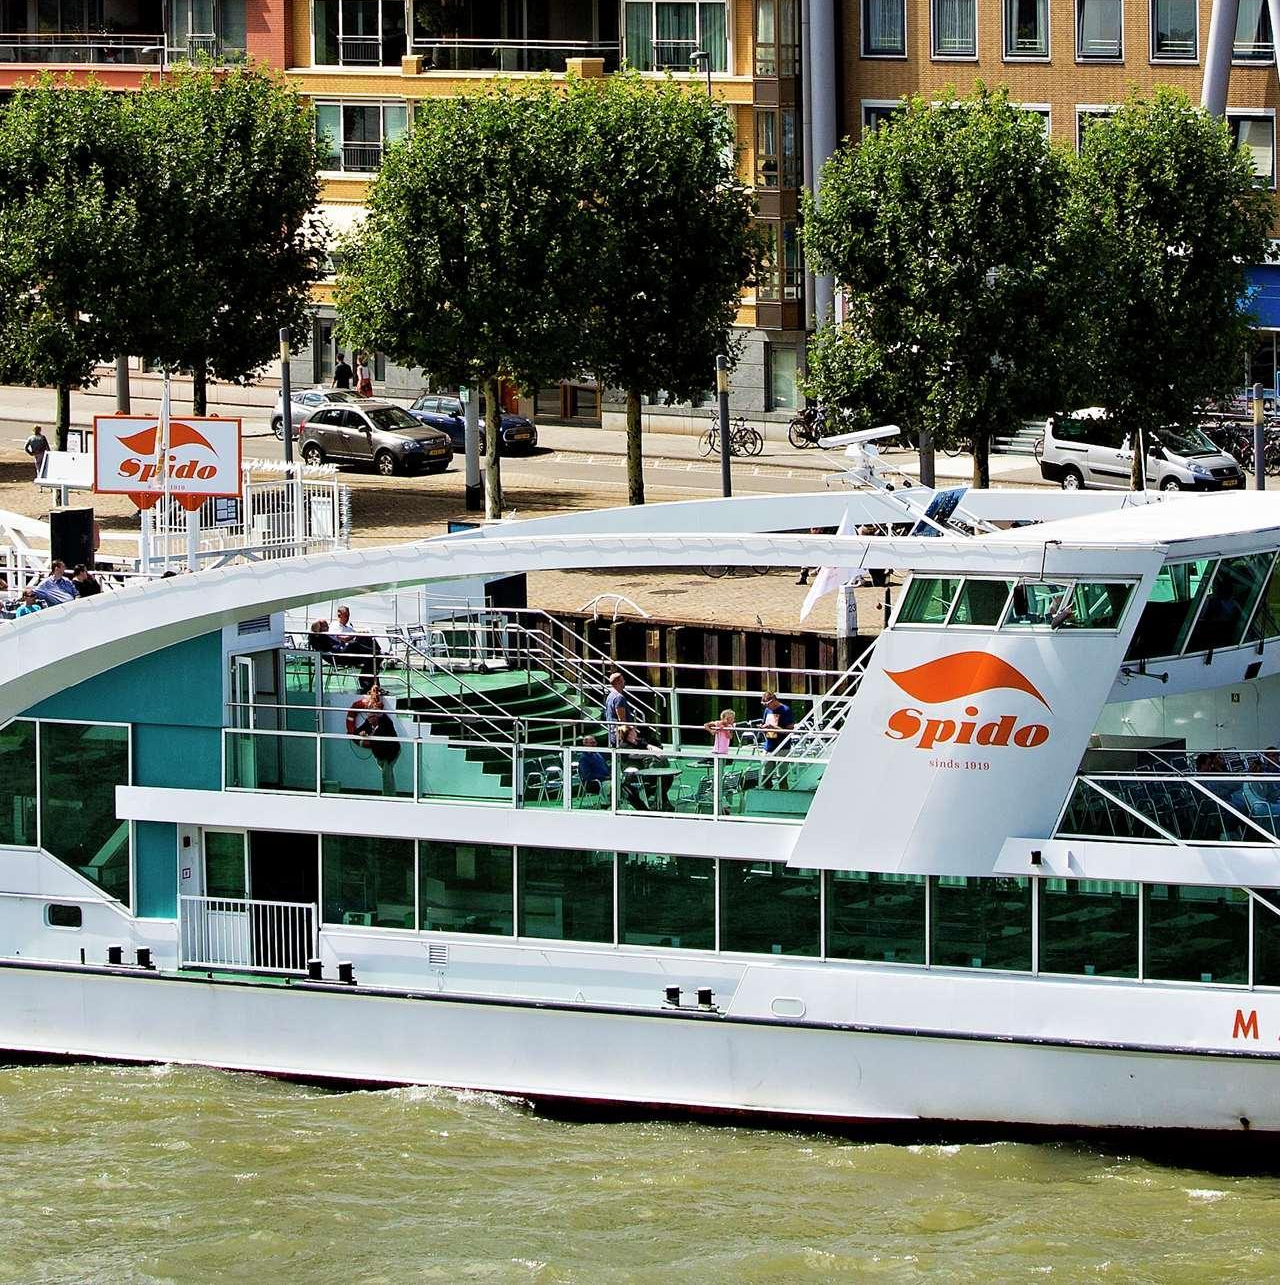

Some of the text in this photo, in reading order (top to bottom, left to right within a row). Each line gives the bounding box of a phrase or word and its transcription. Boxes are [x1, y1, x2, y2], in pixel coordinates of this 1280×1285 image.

[884, 706, 1050, 750] Spido
[928, 759, 990, 771] sinds 1919
